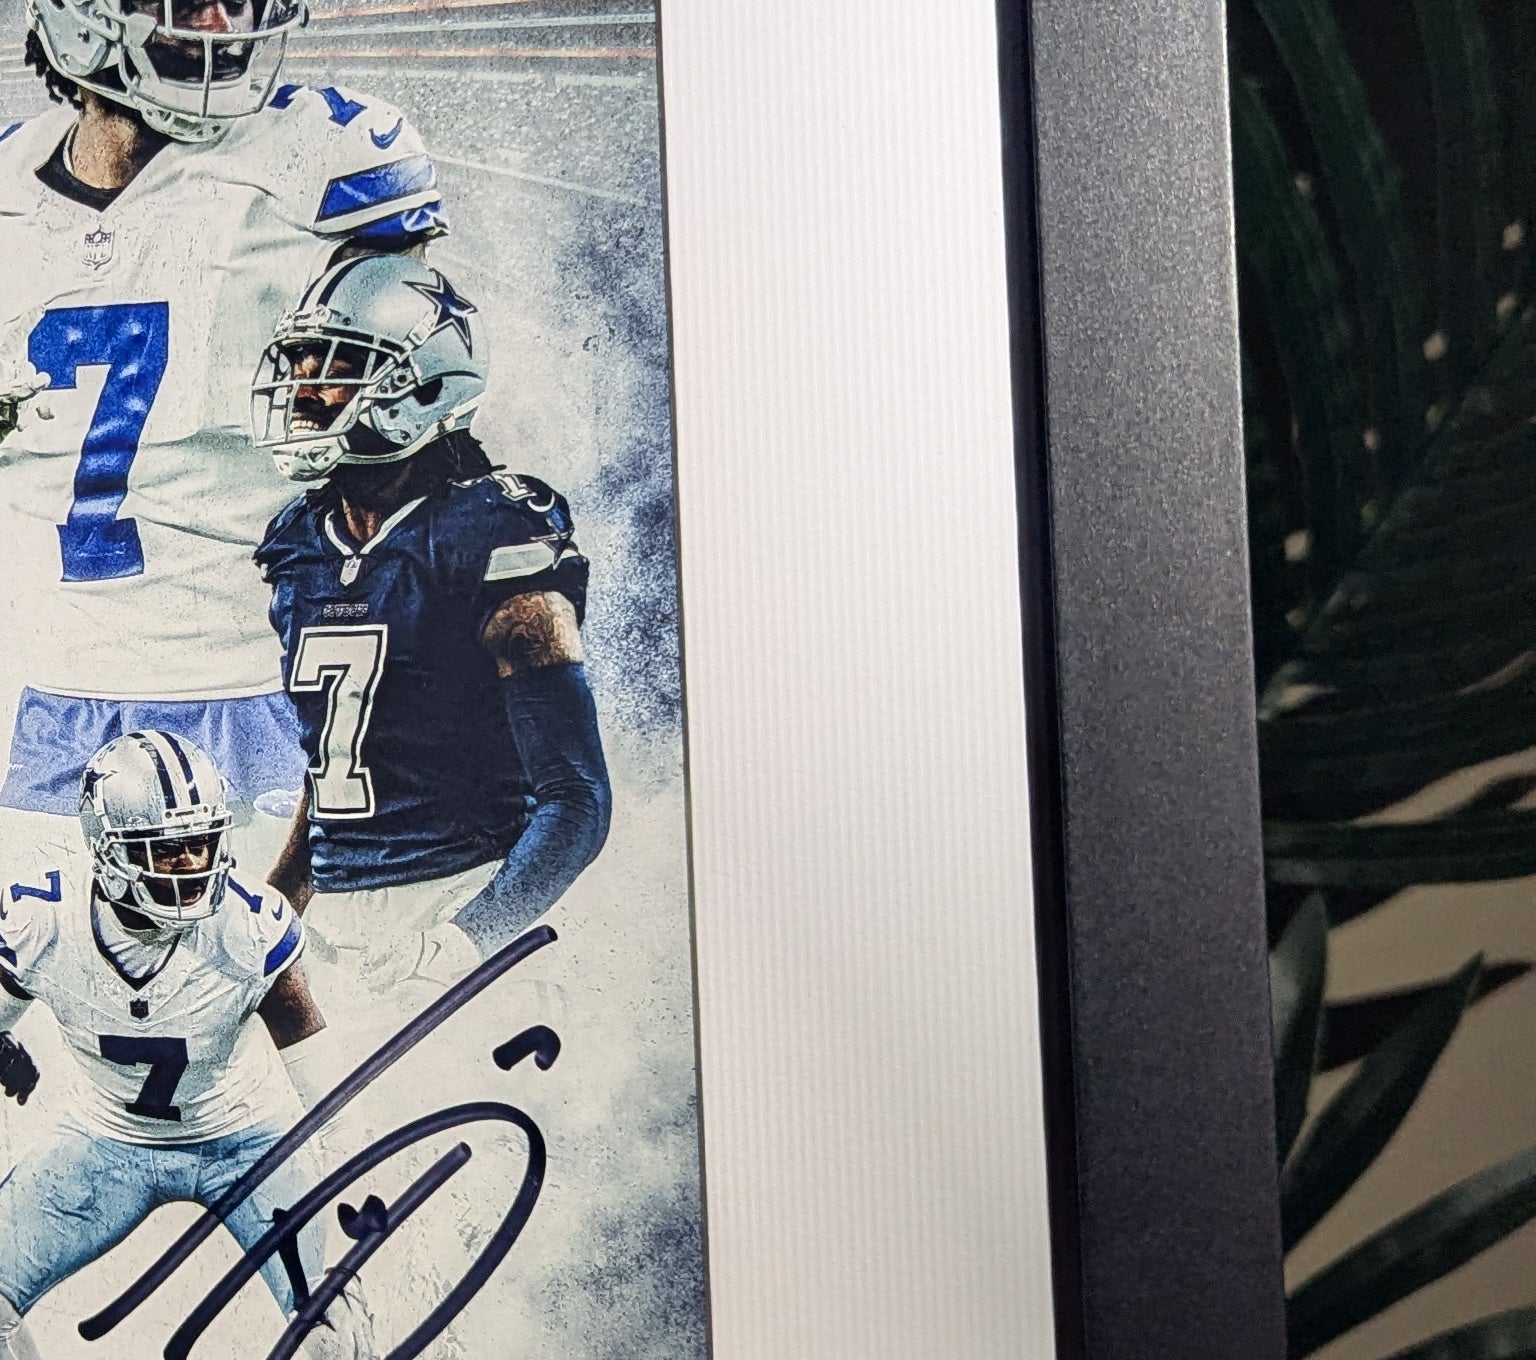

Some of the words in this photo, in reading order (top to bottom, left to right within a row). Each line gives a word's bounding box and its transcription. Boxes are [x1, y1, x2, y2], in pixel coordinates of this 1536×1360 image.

[28, 301, 169, 582] 7
[289, 624, 388, 820] 7
[98, 1035, 189, 1122] 7
